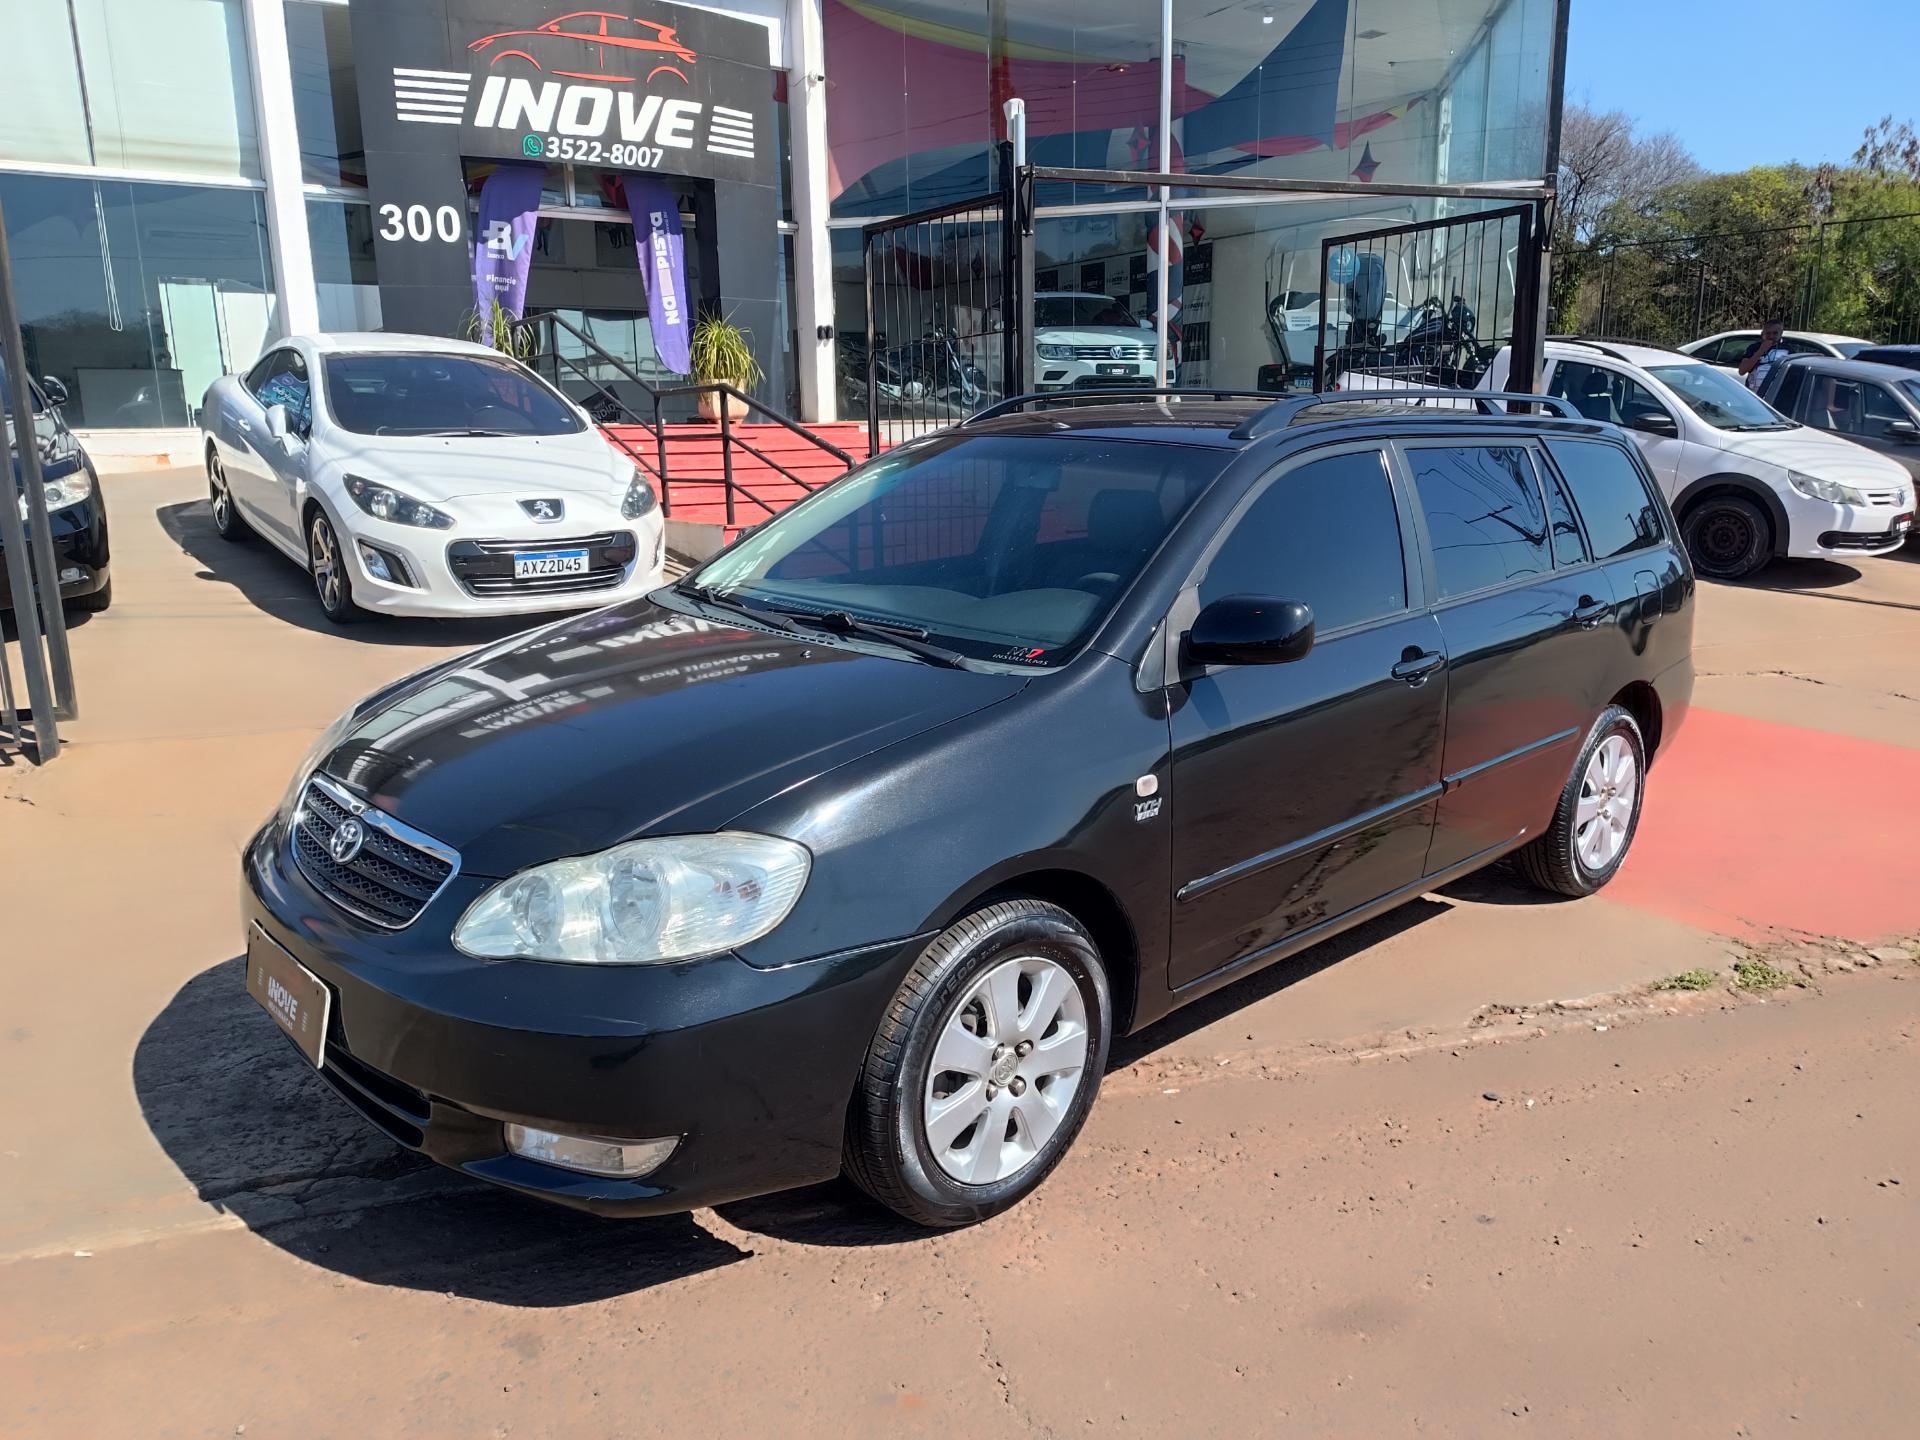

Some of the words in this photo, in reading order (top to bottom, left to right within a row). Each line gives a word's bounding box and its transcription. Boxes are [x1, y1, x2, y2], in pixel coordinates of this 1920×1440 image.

[474, 76, 702, 149] INOVE
[546, 136, 664, 168] 3522-8007
[379, 204, 461, 242] 300
[486, 274, 517, 285] Financie
[494, 284, 510, 293] aqui
[522, 558, 581, 574] AXZ2D45
[268, 976, 298, 1021] INOVE
